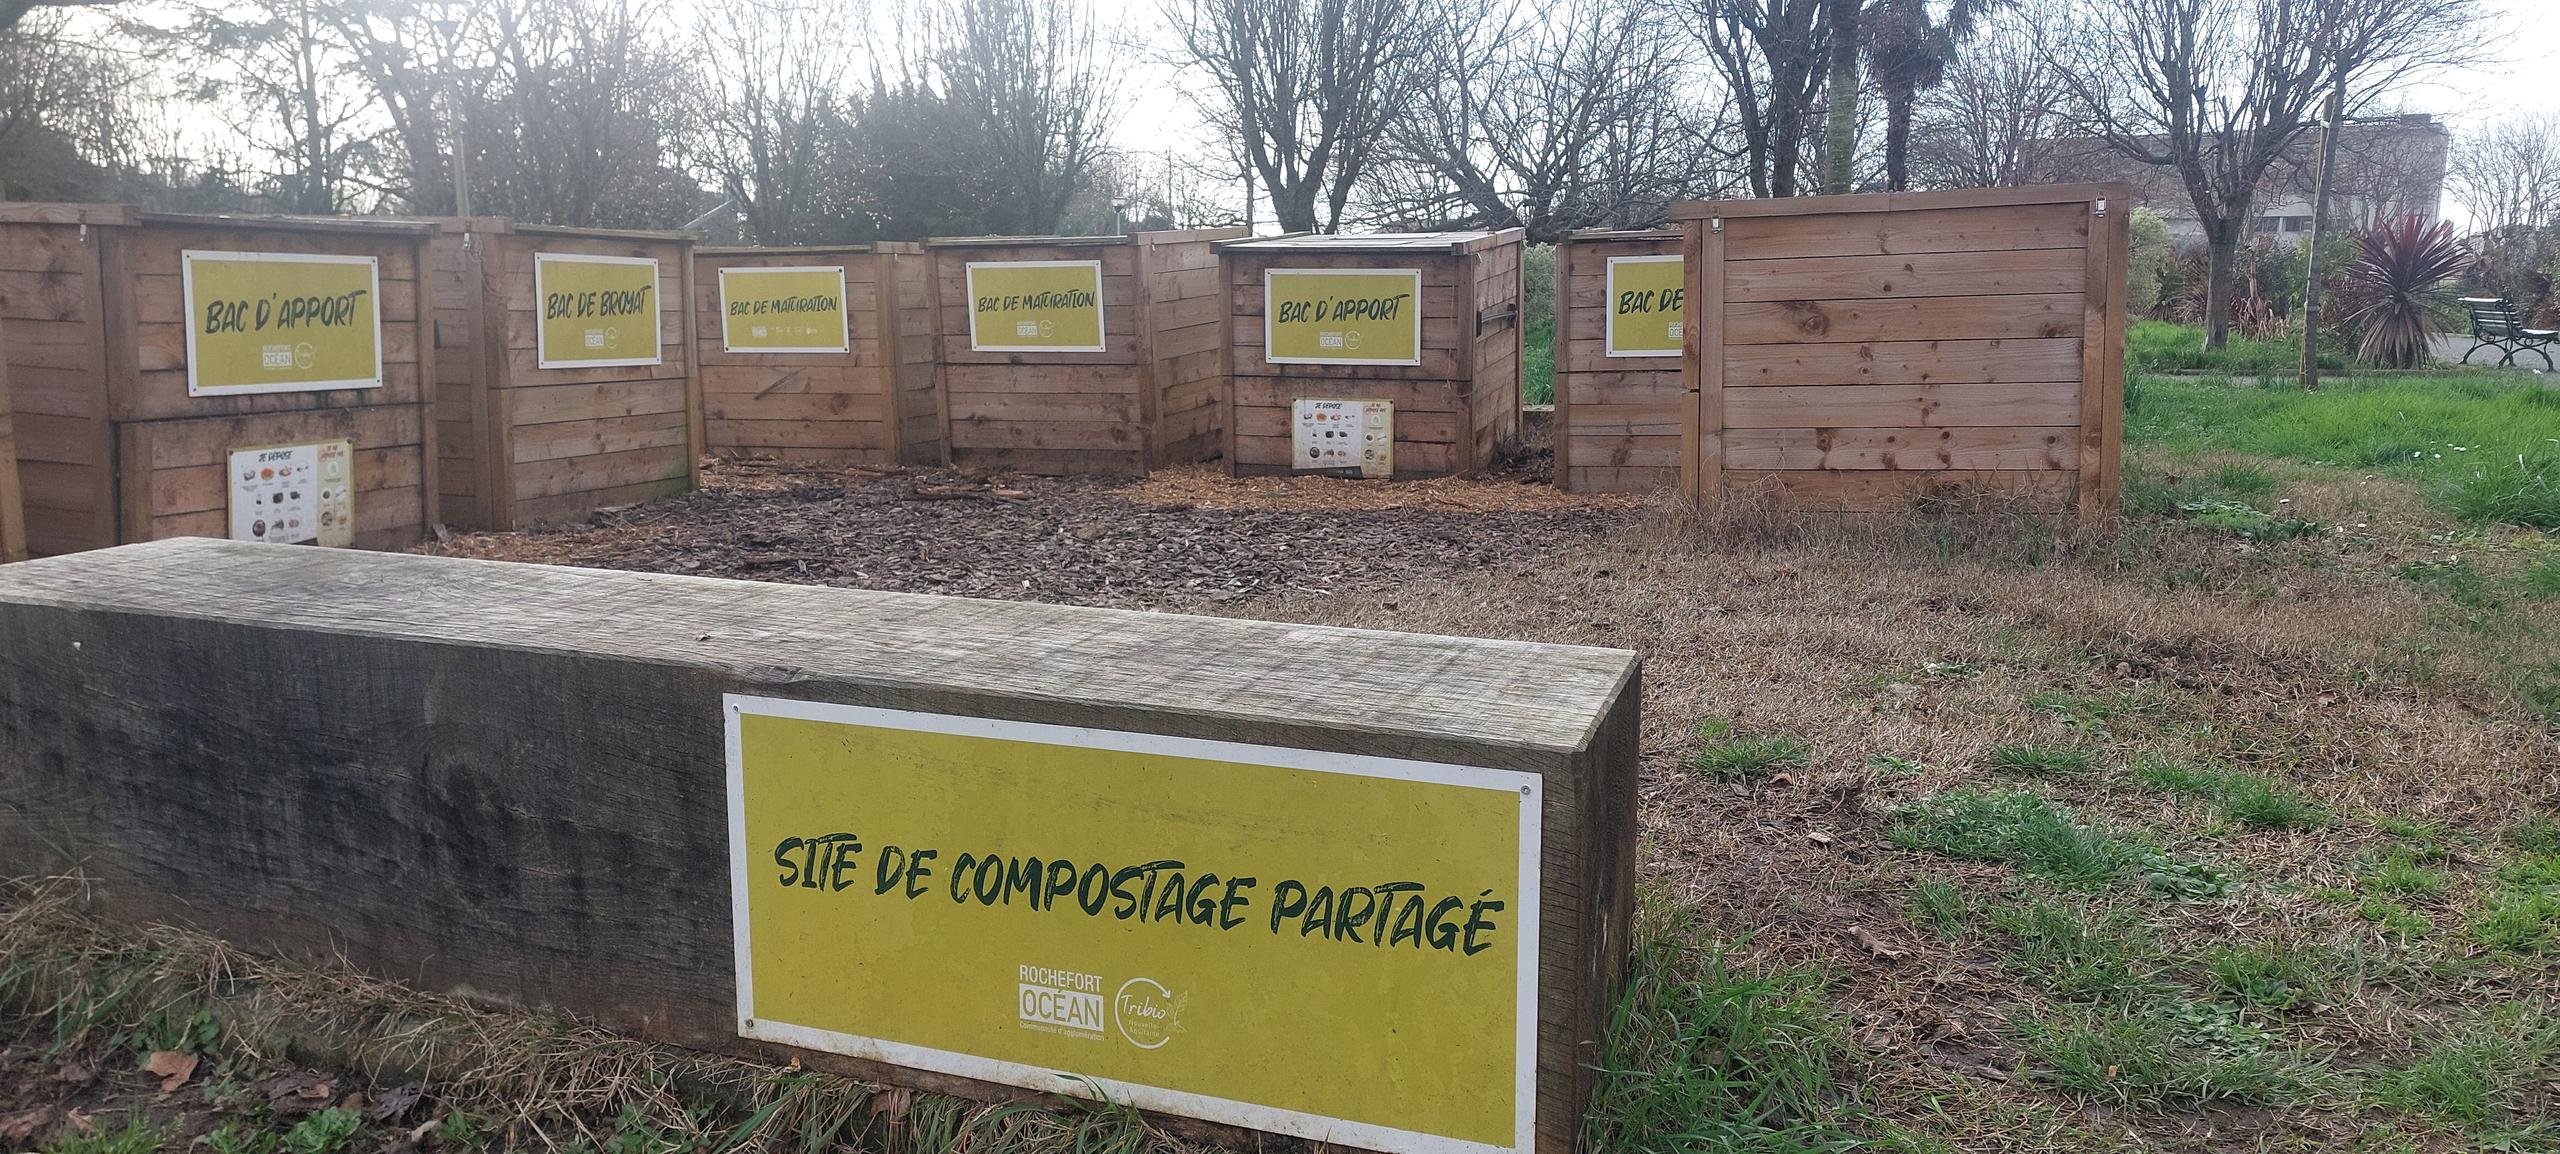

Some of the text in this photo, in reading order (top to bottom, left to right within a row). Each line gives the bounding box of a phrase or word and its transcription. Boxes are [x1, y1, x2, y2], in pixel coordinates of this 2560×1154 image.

[205, 290, 367, 334] BAC D'APPORT
[547, 285, 652, 319] BAC DE BROYAT
[730, 295, 838, 316] BAC DE MATURATION
[978, 288, 1095, 313] BAC DE MATURATION
[1278, 294, 1410, 323] BAC D'APPORT
[1618, 288, 1684, 315] BAC DE
[774, 832, 1505, 957] SITE DE COMPOSTAGE PARTAGÉ
[1019, 964, 1103, 993] ROCHEFORT
[1022, 989, 1101, 1028] OCÉAN
[1121, 994, 1167, 1020] Tribio
